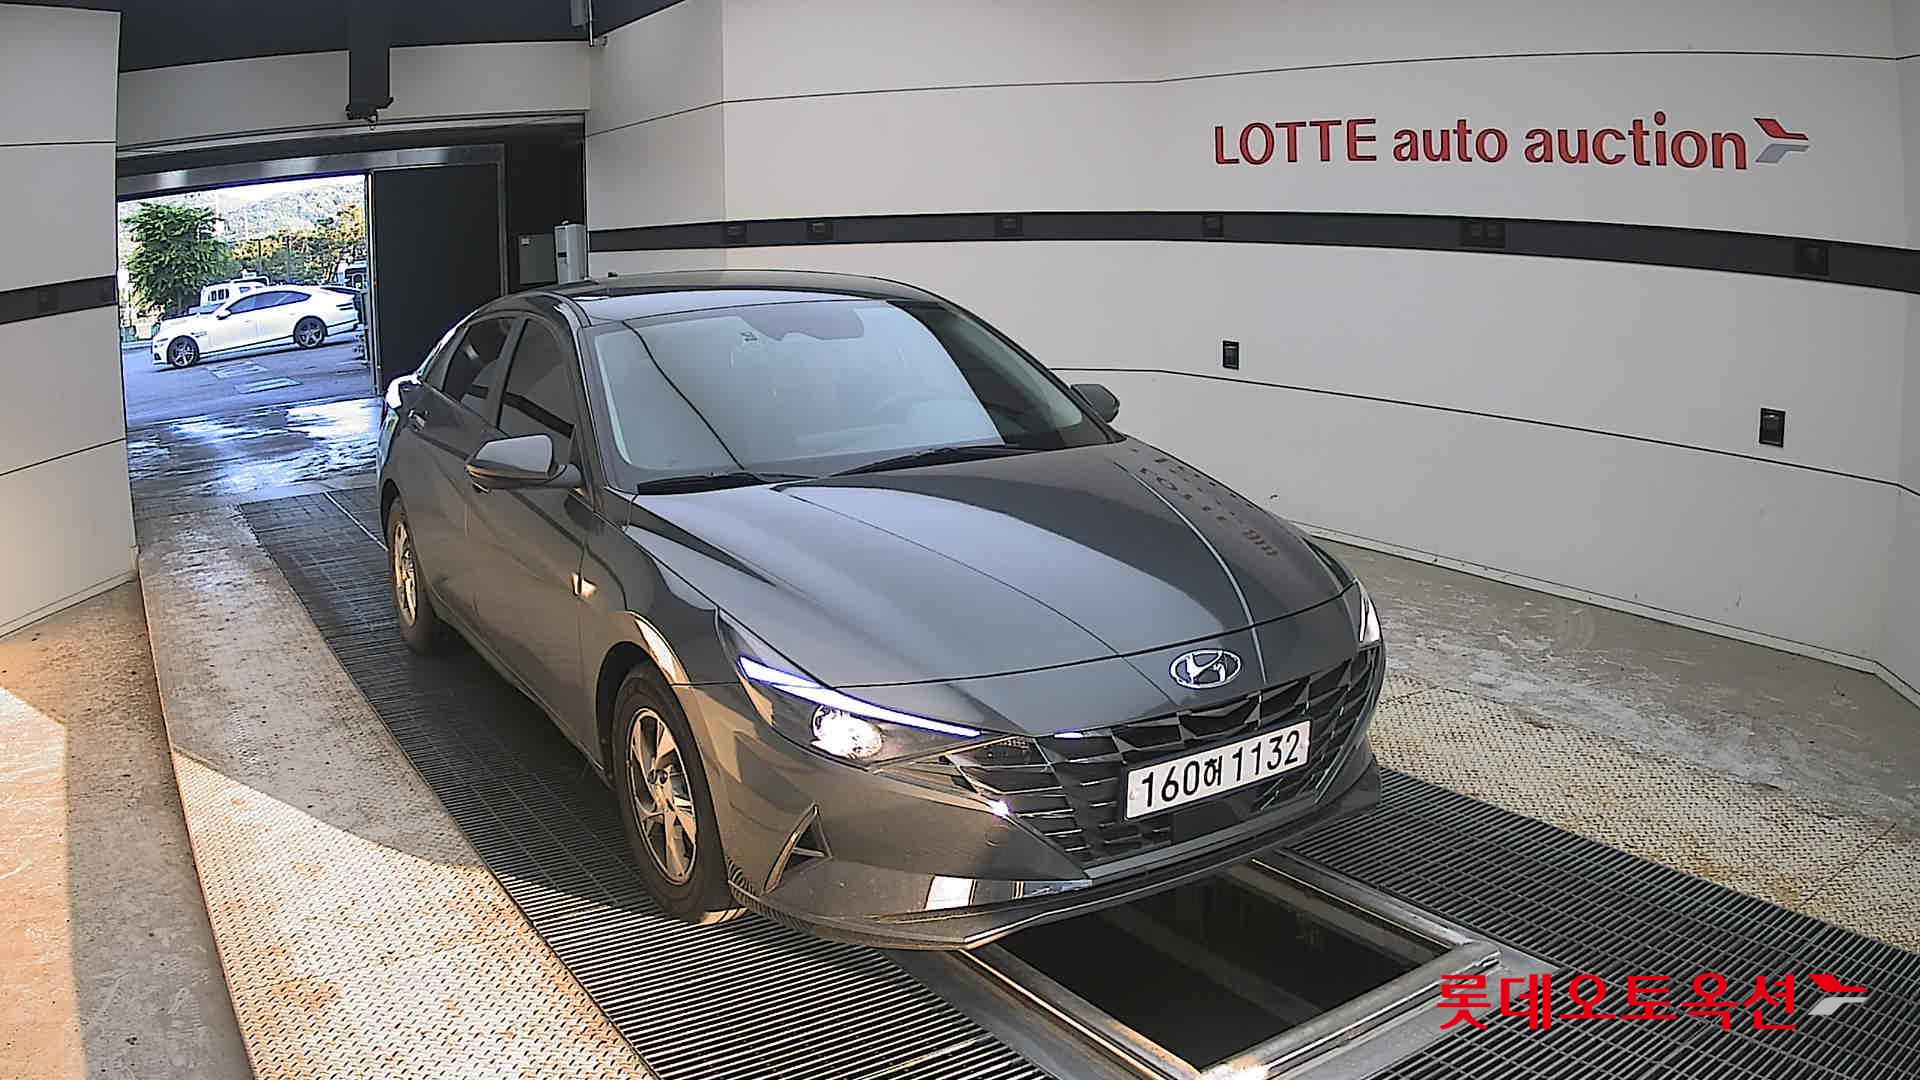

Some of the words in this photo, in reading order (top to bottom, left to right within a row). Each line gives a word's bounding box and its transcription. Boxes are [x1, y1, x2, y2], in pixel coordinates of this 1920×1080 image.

[1214, 118, 1378, 165] LOTTE
[1392, 119, 1509, 163] auto
[1523, 111, 1749, 170] auction
[1231, 729, 1300, 782] 1132
